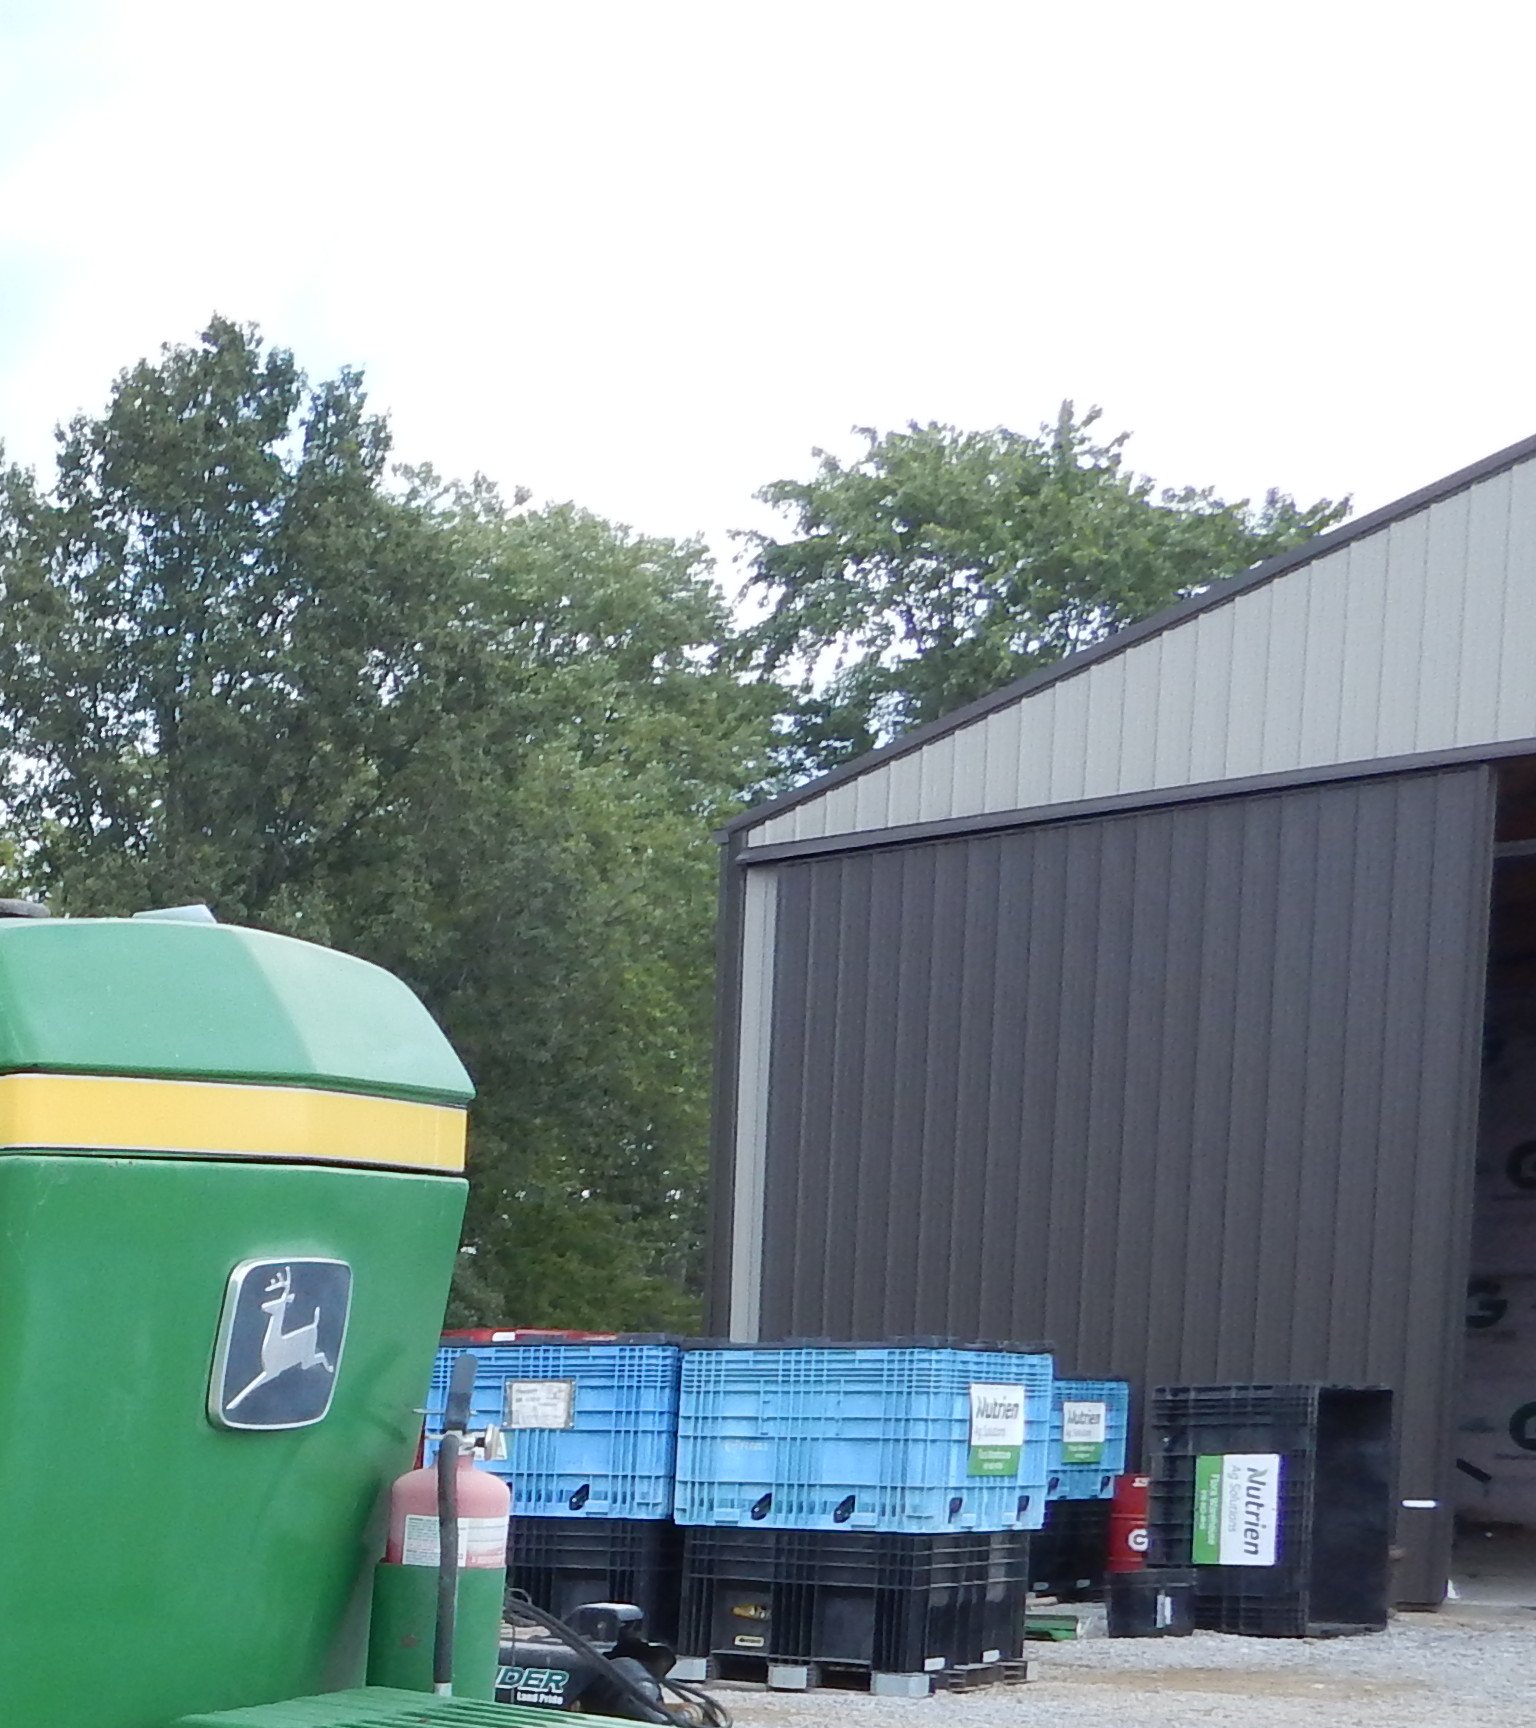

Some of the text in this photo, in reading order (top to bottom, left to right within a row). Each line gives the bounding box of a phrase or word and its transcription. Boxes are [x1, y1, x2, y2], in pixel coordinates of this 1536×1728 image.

[975, 1396, 1020, 1420] Nutrien
[1228, 1483, 1241, 1532] Solutions
[1243, 1466, 1269, 1556] Nutrien
[495, 1666, 569, 1693] DER
